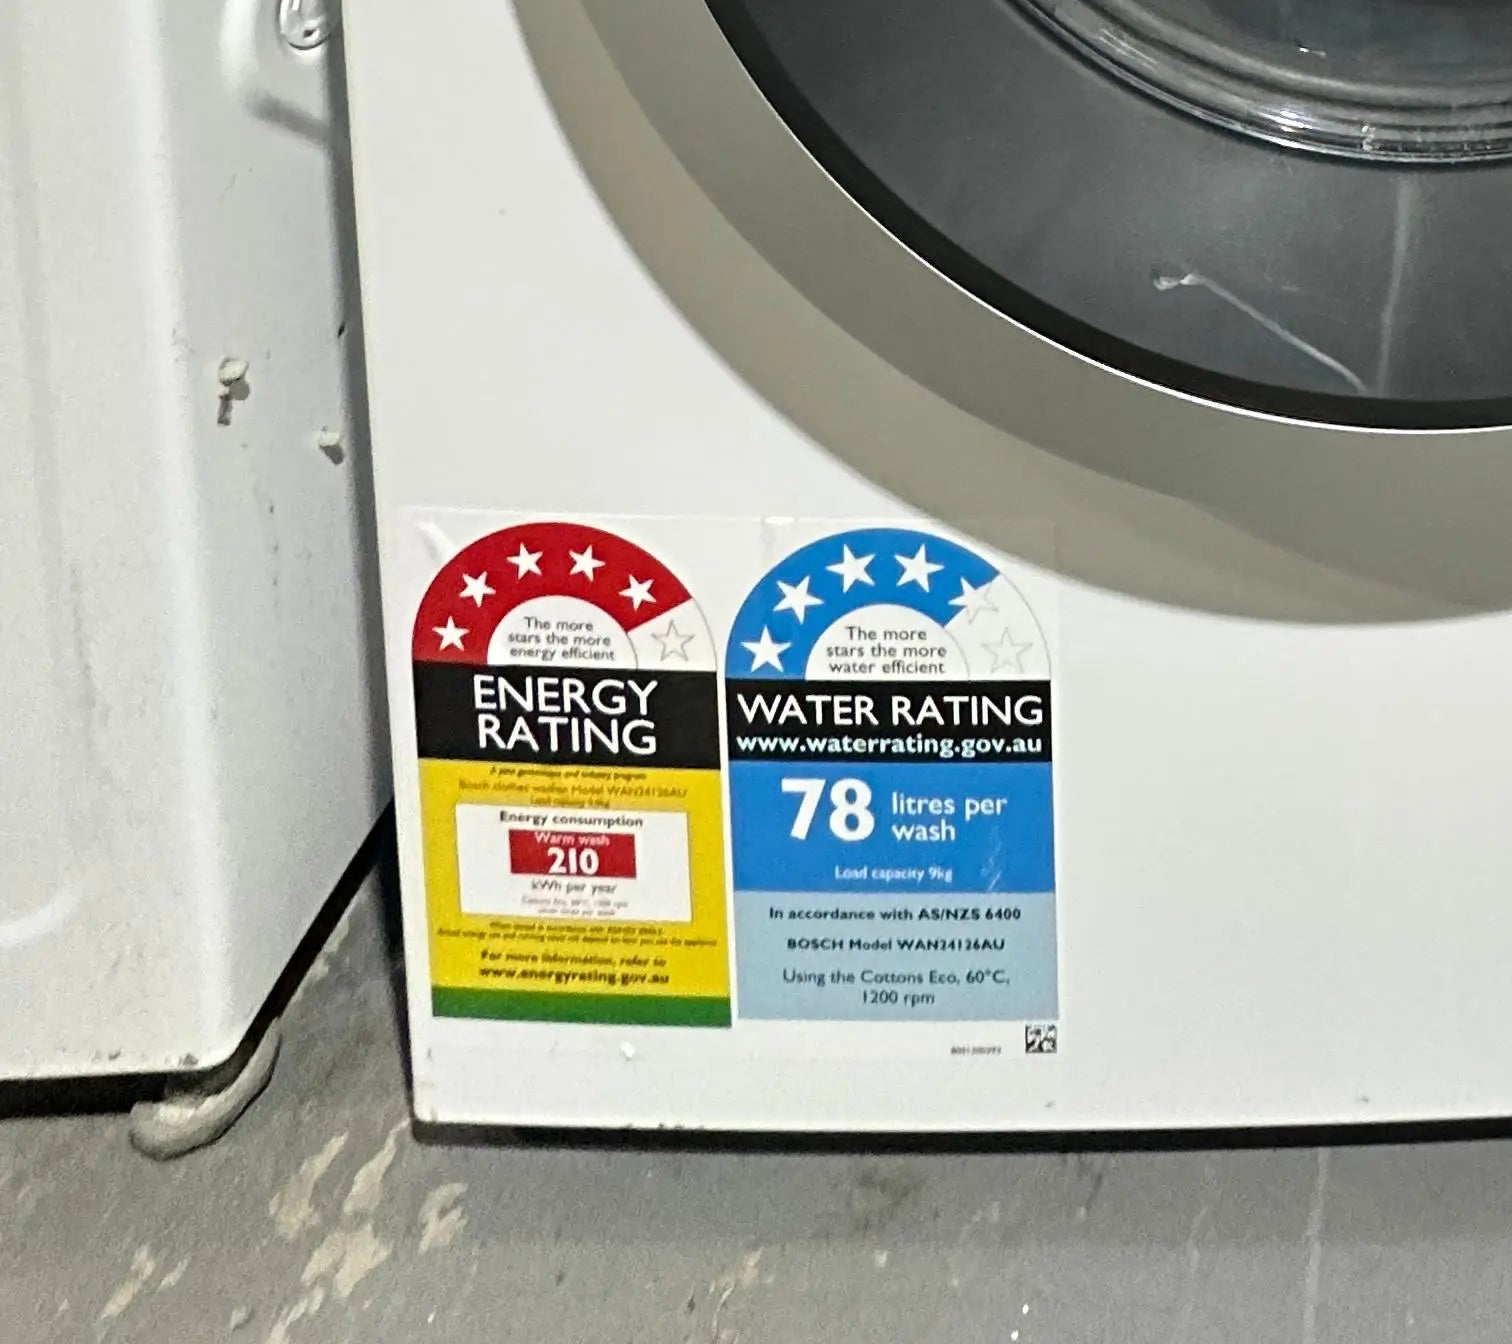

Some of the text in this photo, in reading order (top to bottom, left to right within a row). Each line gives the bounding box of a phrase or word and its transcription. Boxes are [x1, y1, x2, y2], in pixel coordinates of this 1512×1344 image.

[524, 615, 594, 632] The more
[508, 631, 611, 647] stars the more
[846, 626, 927, 641] The more
[510, 647, 615, 662] energy efficient
[827, 643, 947, 658] stars the more
[829, 658, 946, 674] water efficient
[473, 673, 658, 716] ENERGY
[737, 693, 1043, 725] WATER RATING
[477, 714, 657, 755] RATING
[736, 732, 1042, 759] www.waterrating.gov.au
[781, 778, 1007, 841] 78 litres per
[500, 810, 643, 829] Energy consumption
[534, 831, 611, 847] Warm wash
[892, 819, 955, 841] wash
[547, 847, 600, 875] 210
[835, 865, 867, 880] Load
[872, 866, 924, 883] capacity
[531, 879, 617, 896] kWh per year
[769, 906, 1021, 922] In accordance with AS/NZS 6400
[787, 938, 844, 951] BOSCH
[849, 938, 892, 951] Model
[479, 966, 669, 986] www.energyrating.gov.au
[783, 967, 826, 987] Using
[831, 968, 855, 985] the
[861, 968, 924, 985] Cottons
[929, 968, 961, 987] Eco,
[863, 990, 935, 1008] 1200 rpm
